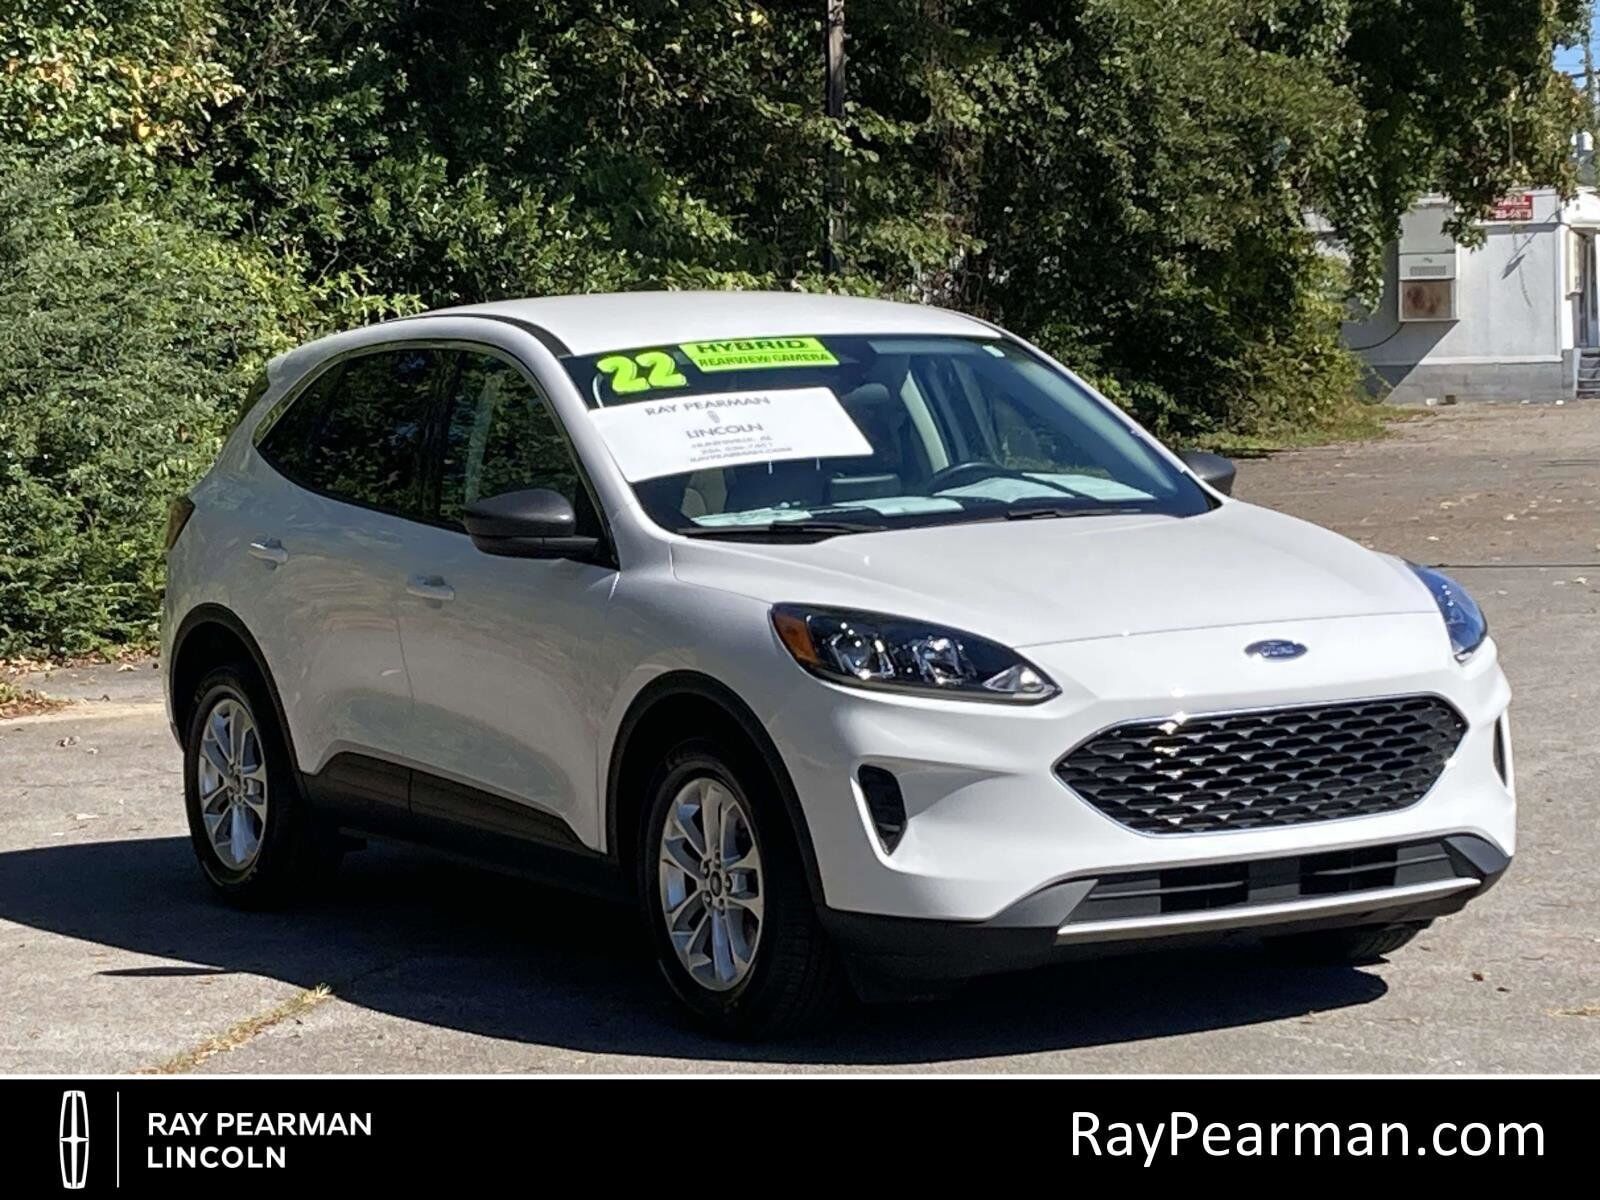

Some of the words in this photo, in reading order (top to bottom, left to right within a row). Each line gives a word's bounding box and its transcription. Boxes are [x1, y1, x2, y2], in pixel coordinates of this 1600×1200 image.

[695, 340, 807, 354] HYBRID
[698, 355, 771, 367] REARVIEW
[772, 353, 832, 363] CAMERA
[596, 351, 688, 393] 22
[644, 404, 677, 416] RAY
[684, 396, 772, 412] PEARMAN
[686, 423, 765, 439] LINCOLN
